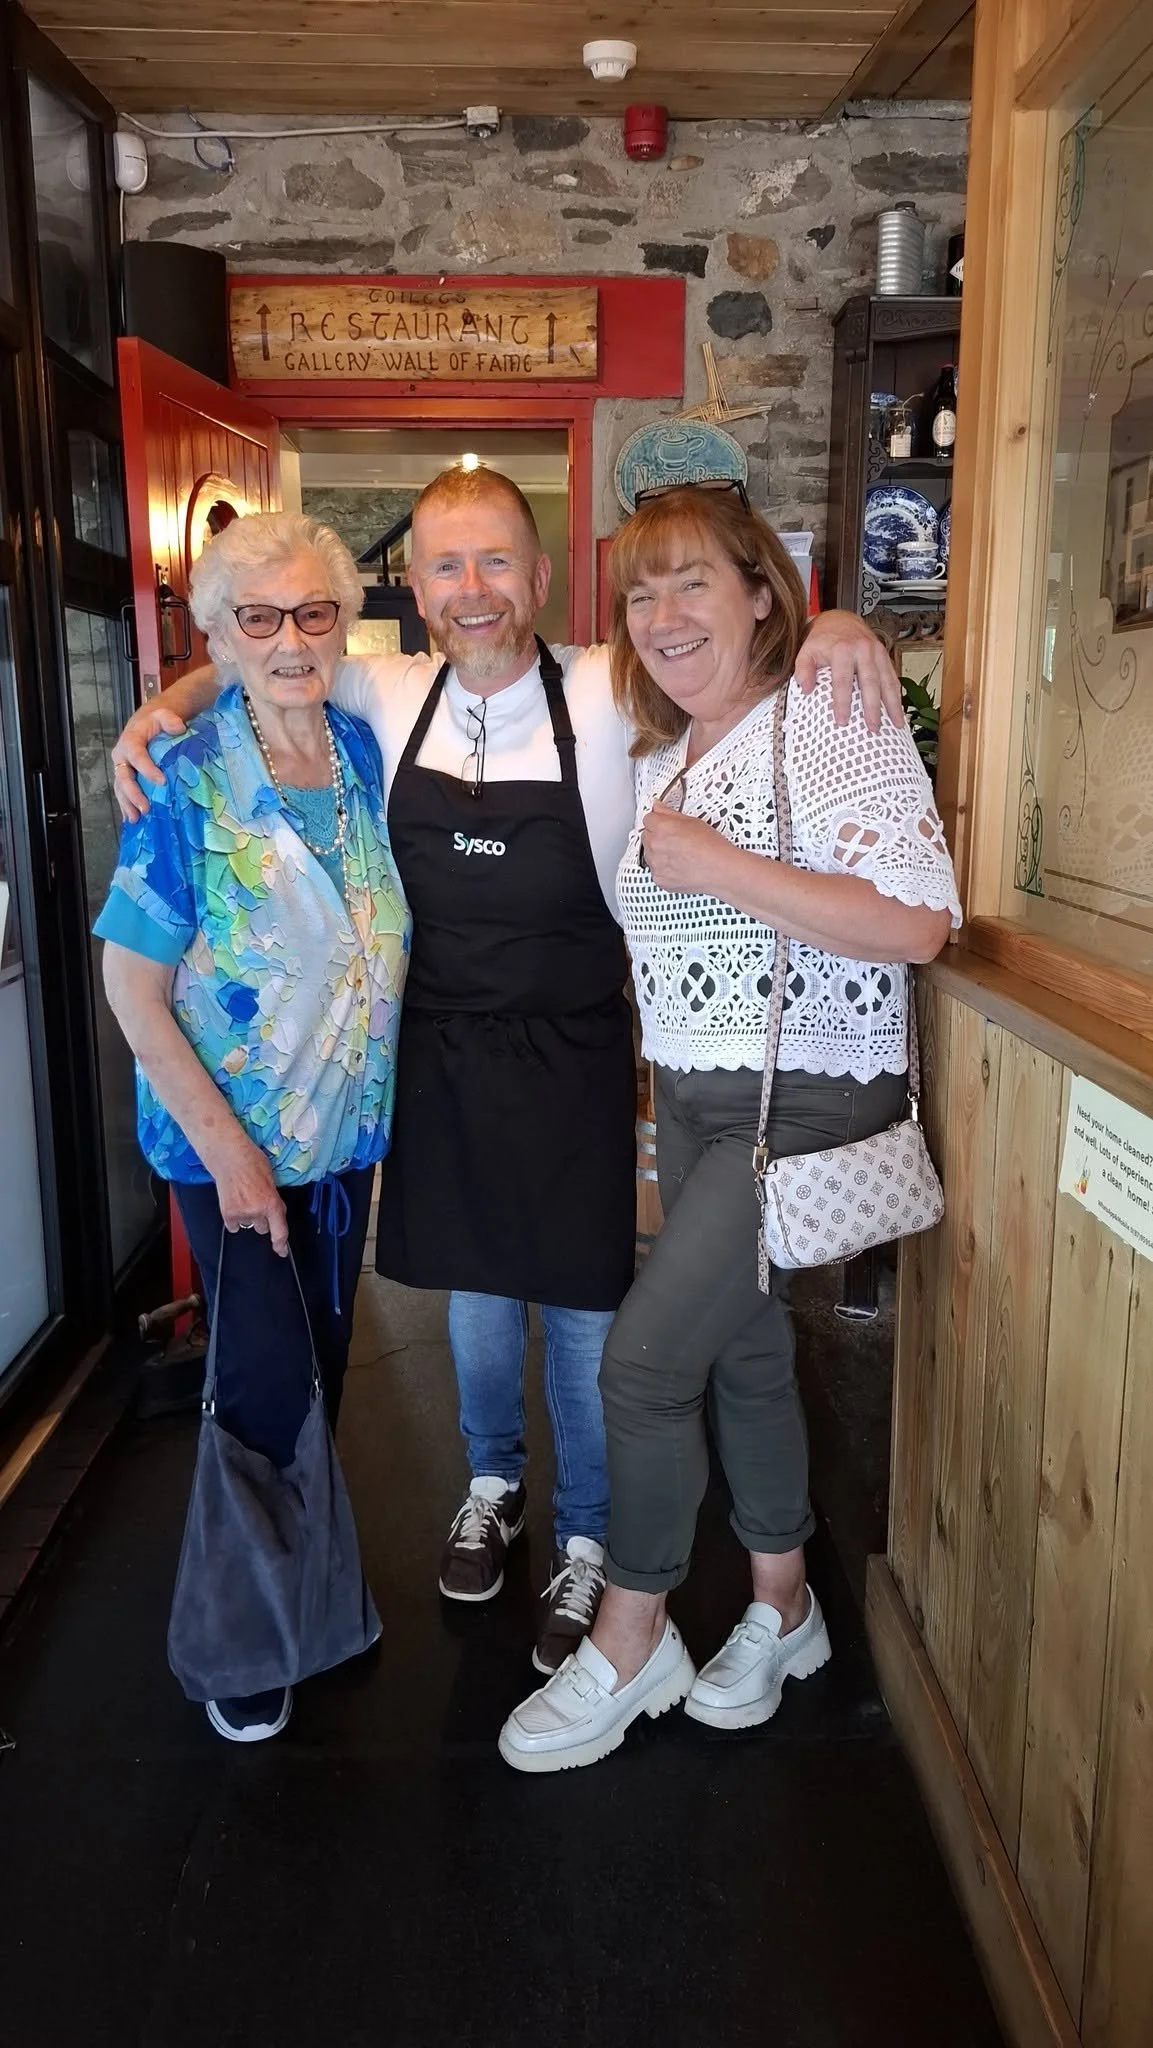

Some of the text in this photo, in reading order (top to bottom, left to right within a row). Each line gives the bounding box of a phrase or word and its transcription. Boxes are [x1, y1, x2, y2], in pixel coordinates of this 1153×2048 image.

[368, 288, 467, 305] TOILETS
[290, 309, 529, 345] RESTAURANT
[284, 352, 532, 373] GALLERY WALL OF FAME
[453, 832, 506, 856] Sysco
[1073, 1125, 1085, 1139] and
[1099, 1141, 1111, 1160] Lots
[1112, 1154, 1119, 1166] of
[1076, 1104, 1153, 1167] Need your home cleaned?
[1102, 1168, 1106, 1178] a
[1106, 1171, 1122, 1191] clean
[1127, 1185, 1150, 1212] home!
